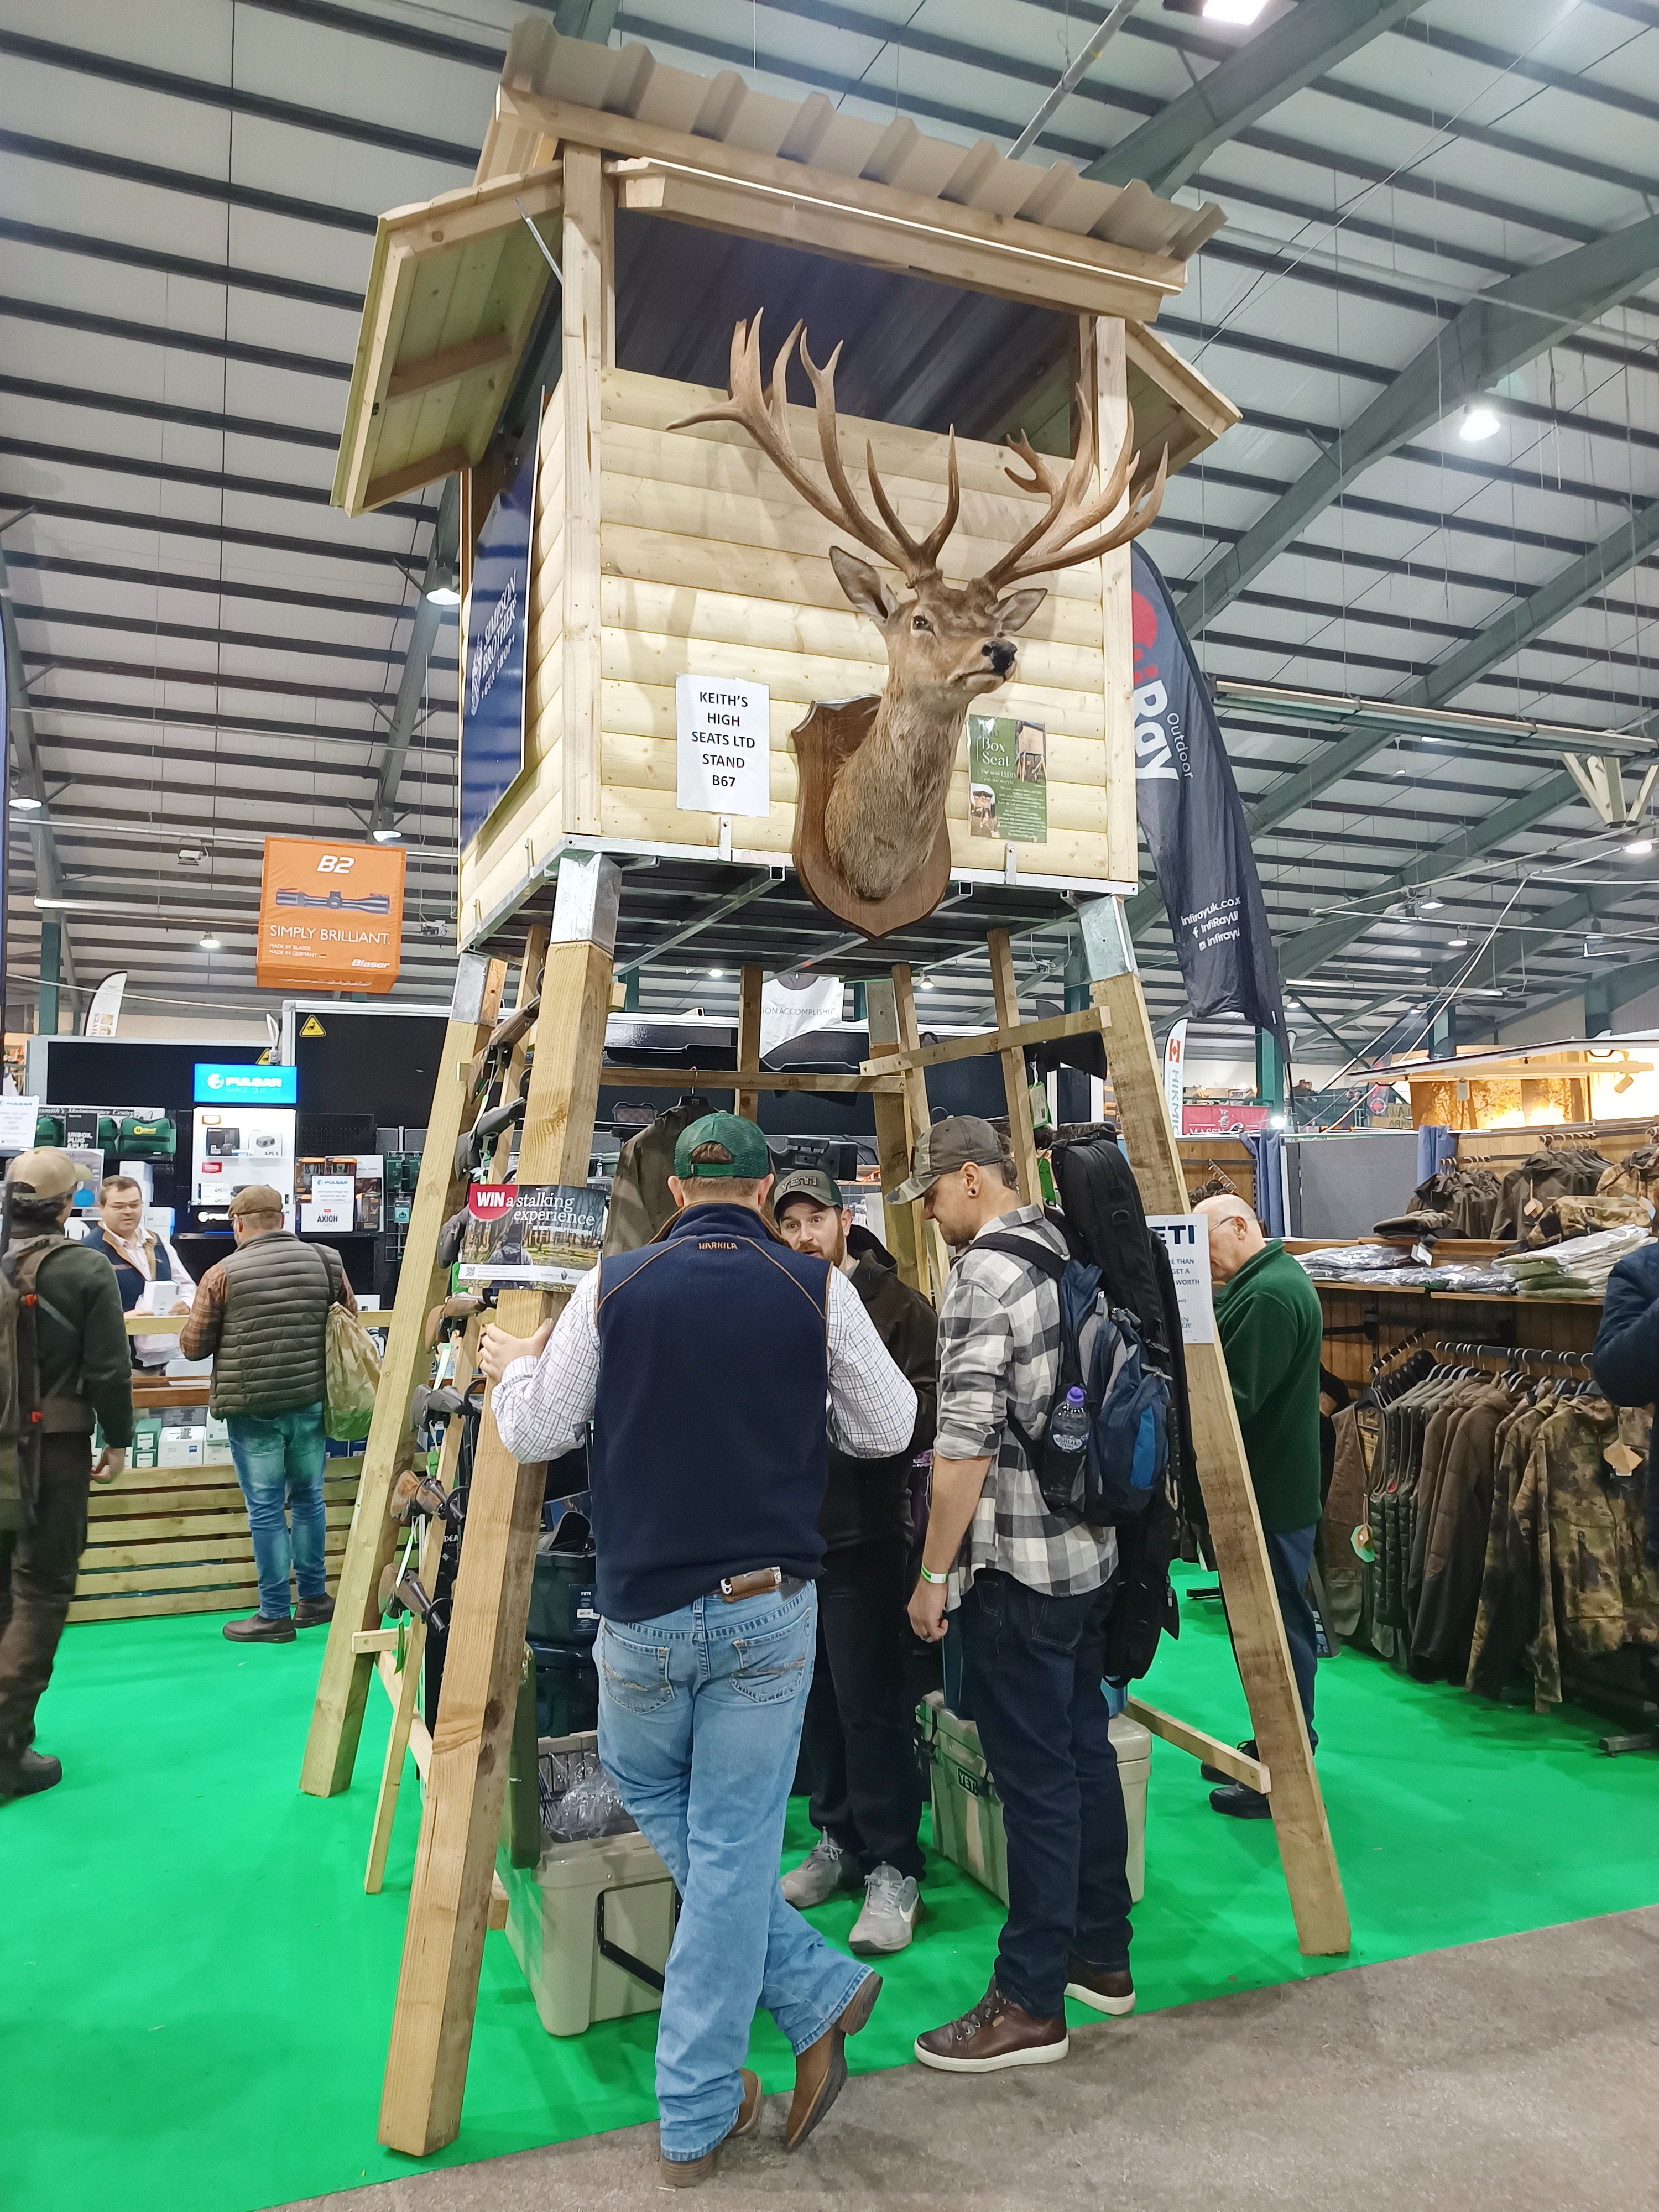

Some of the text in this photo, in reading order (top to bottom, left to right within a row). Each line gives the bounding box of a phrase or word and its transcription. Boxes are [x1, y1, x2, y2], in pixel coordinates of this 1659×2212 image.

[484, 568, 517, 650] SIMPSON
[483, 593, 517, 679] BROTHERS
[700, 691, 748, 707] KEITH'S
[707, 712, 740, 727] HIGH
[691, 731, 755, 748] SEATS LTD
[982, 737, 1005, 753] Box
[1167, 712, 1193, 779] Outdoor
[702, 754, 745, 768] STAND
[982, 751, 1010, 767] Seat
[712, 775, 736, 787] B67
[317, 855, 354, 874] B2
[269, 925, 390, 945] SIMPLY BRILLIANT.
[351, 959, 390, 968] Blaser
[477, 1192, 575, 1213] WIN a stalking
[514, 1208, 594, 1226] experience
[1149, 1225, 1195, 1244] ETI
[444, 1534, 458, 1543] DEA
